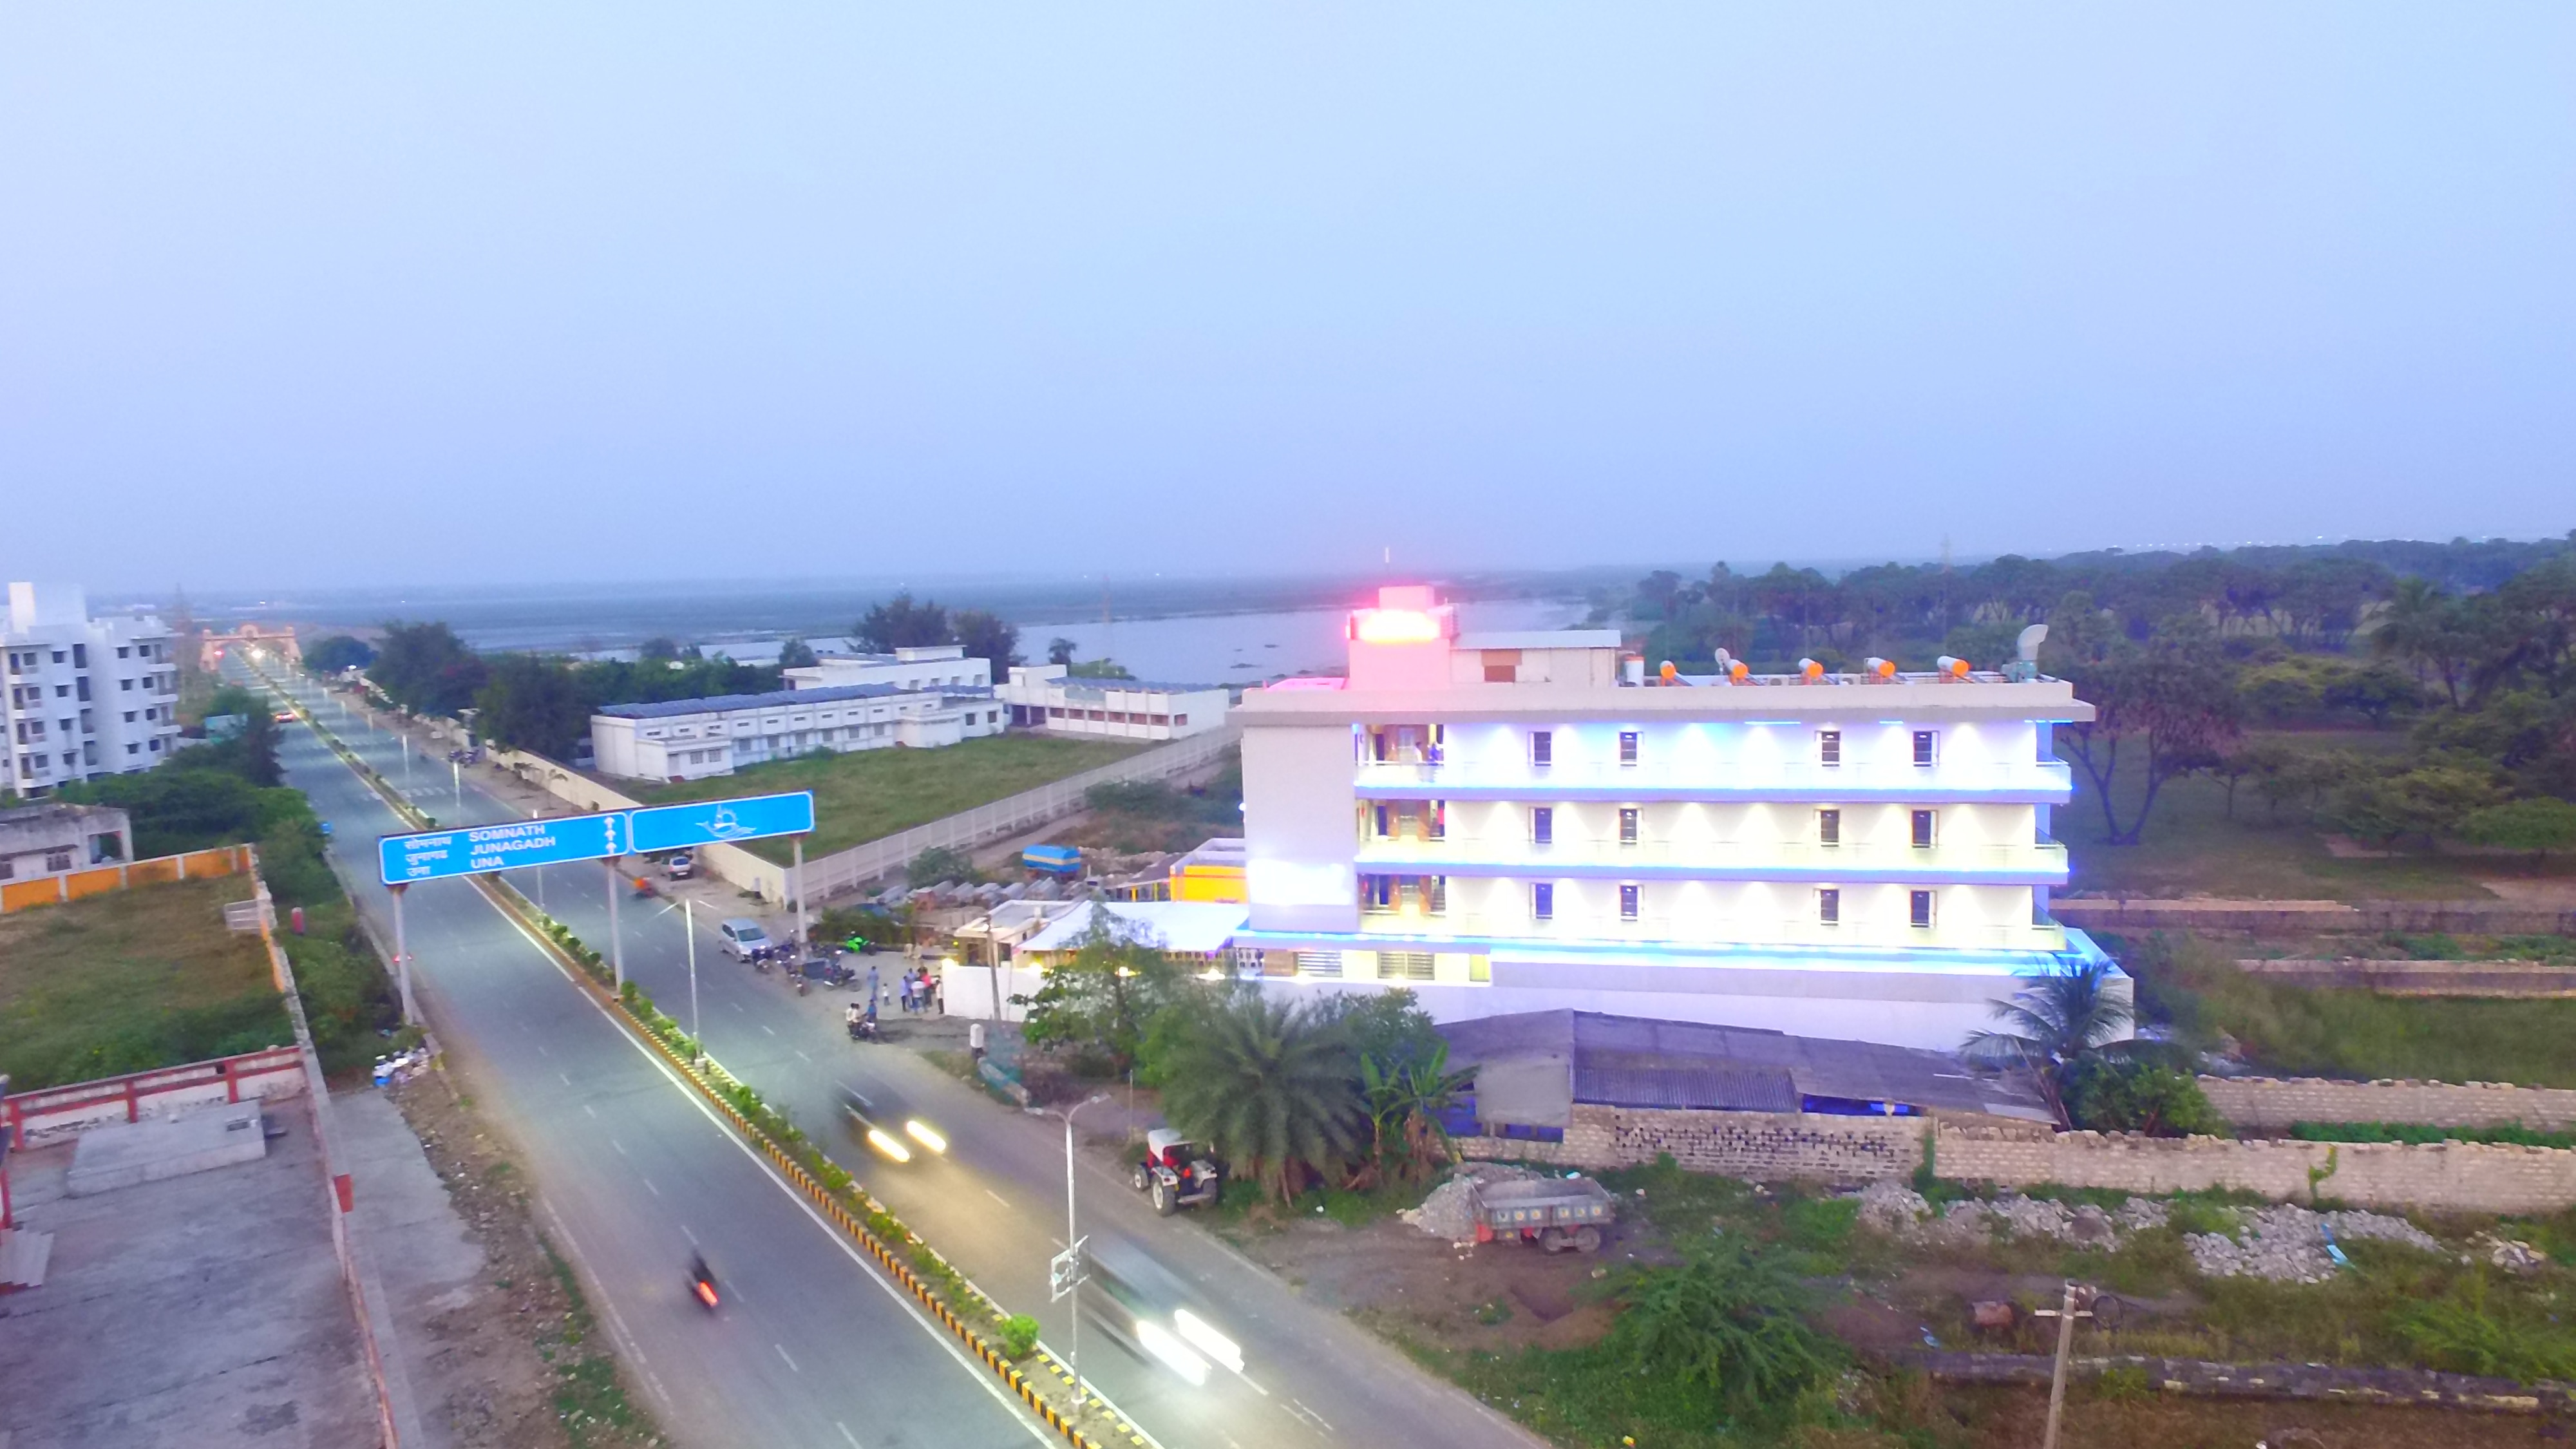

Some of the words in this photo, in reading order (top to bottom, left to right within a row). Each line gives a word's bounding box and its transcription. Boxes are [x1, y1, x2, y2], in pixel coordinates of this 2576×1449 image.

[469, 824, 545, 842] SOMNATH
[470, 837, 556, 855] JUNAGADH
[471, 856, 504, 869] UNA
